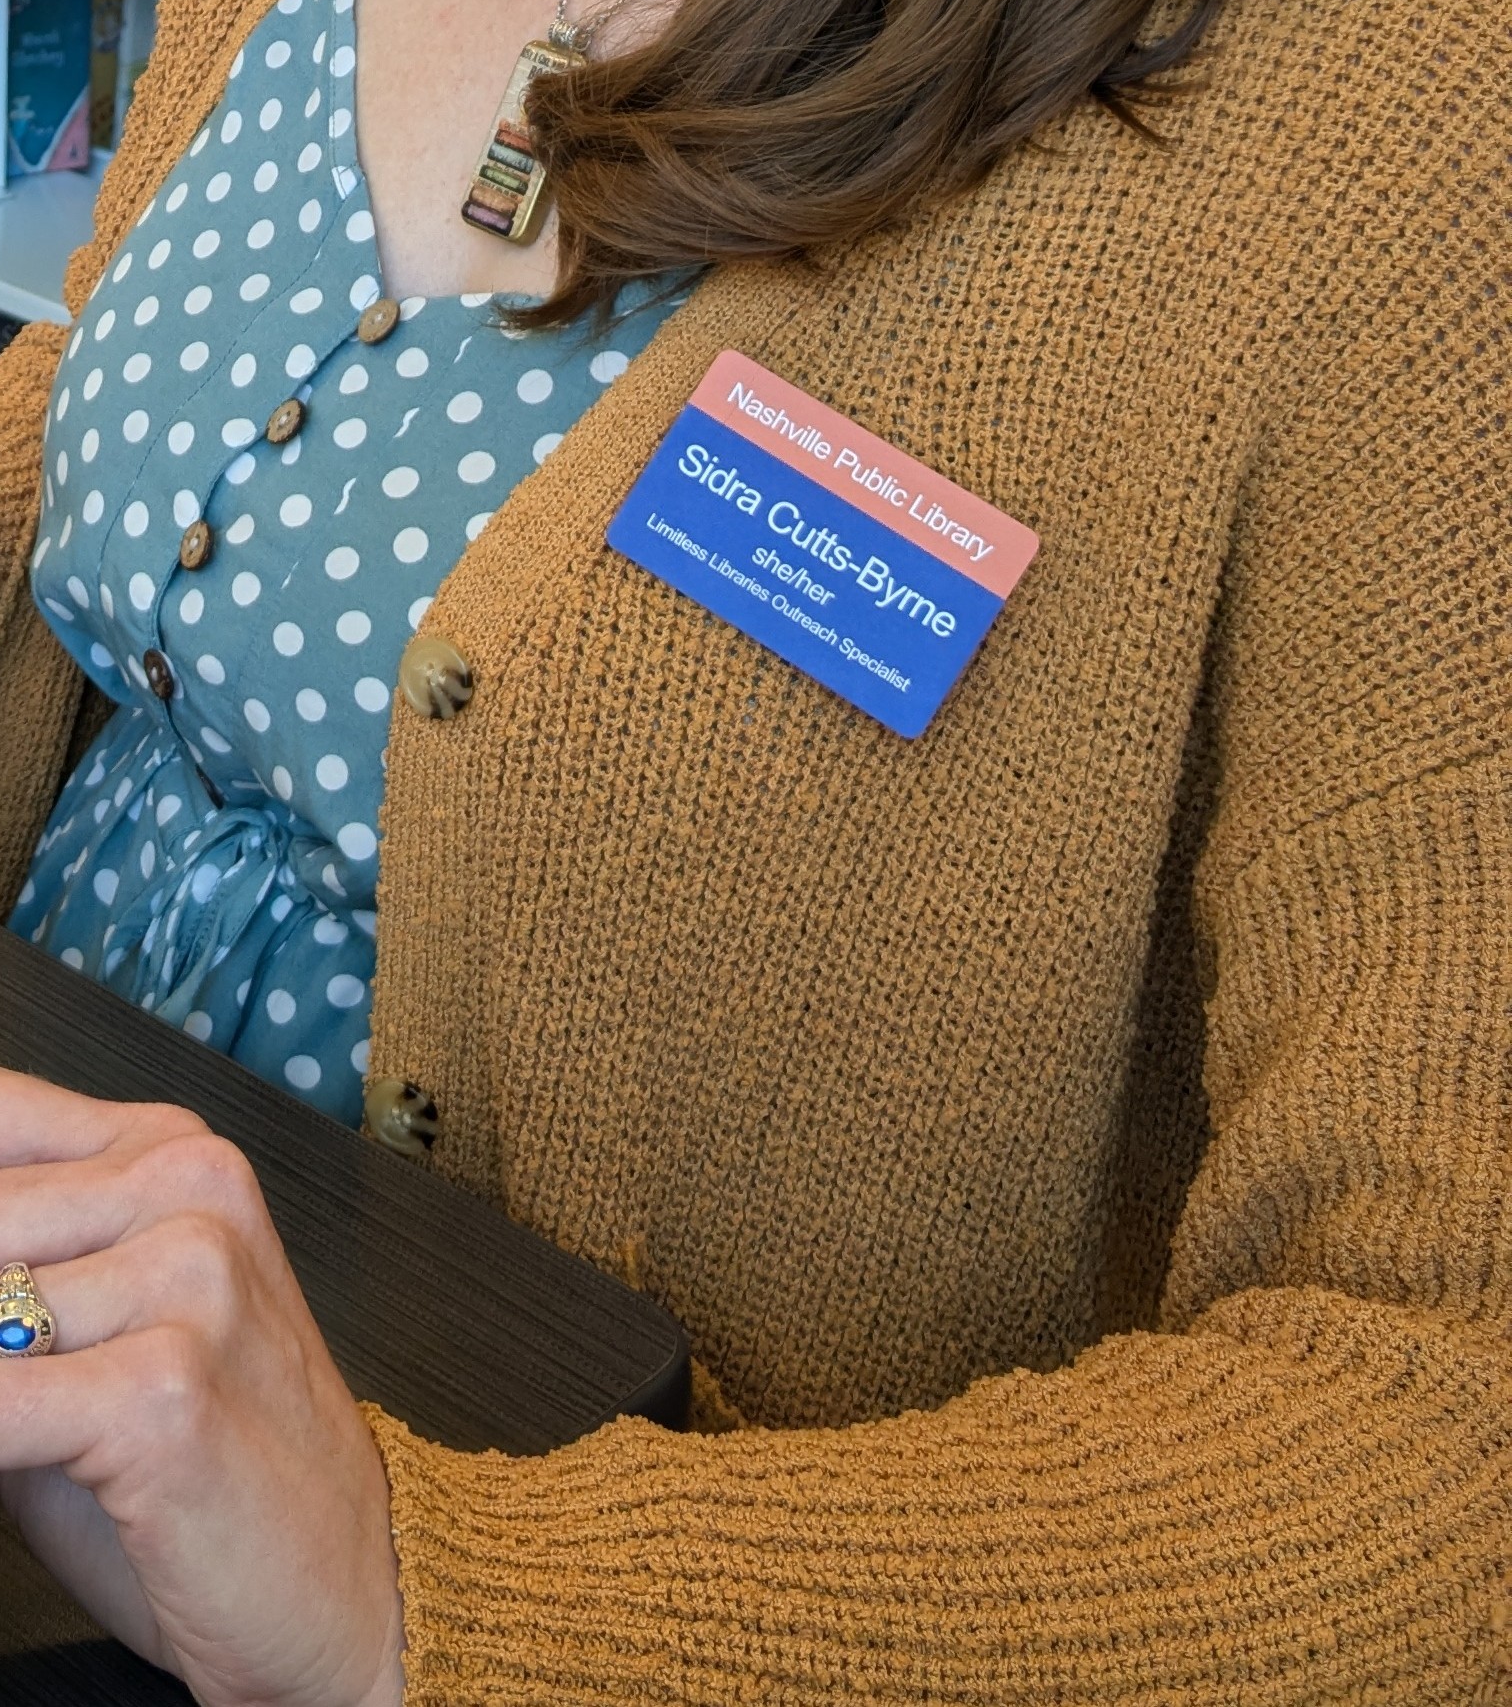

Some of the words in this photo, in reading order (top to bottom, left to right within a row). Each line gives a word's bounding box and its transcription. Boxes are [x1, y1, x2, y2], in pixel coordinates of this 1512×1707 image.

[679, 443, 762, 515] Sidra
[767, 501, 957, 638] Cutts-Byrne
[728, 381, 832, 460] Nashville
[834, 447, 908, 507] Public
[909, 495, 994, 562] Library
[646, 512, 708, 561] Limitless
[709, 552, 770, 600] Libraries
[772, 594, 838, 645] Outreach
[839, 637, 911, 692] Specialist
[752, 545, 835, 606] she/her
